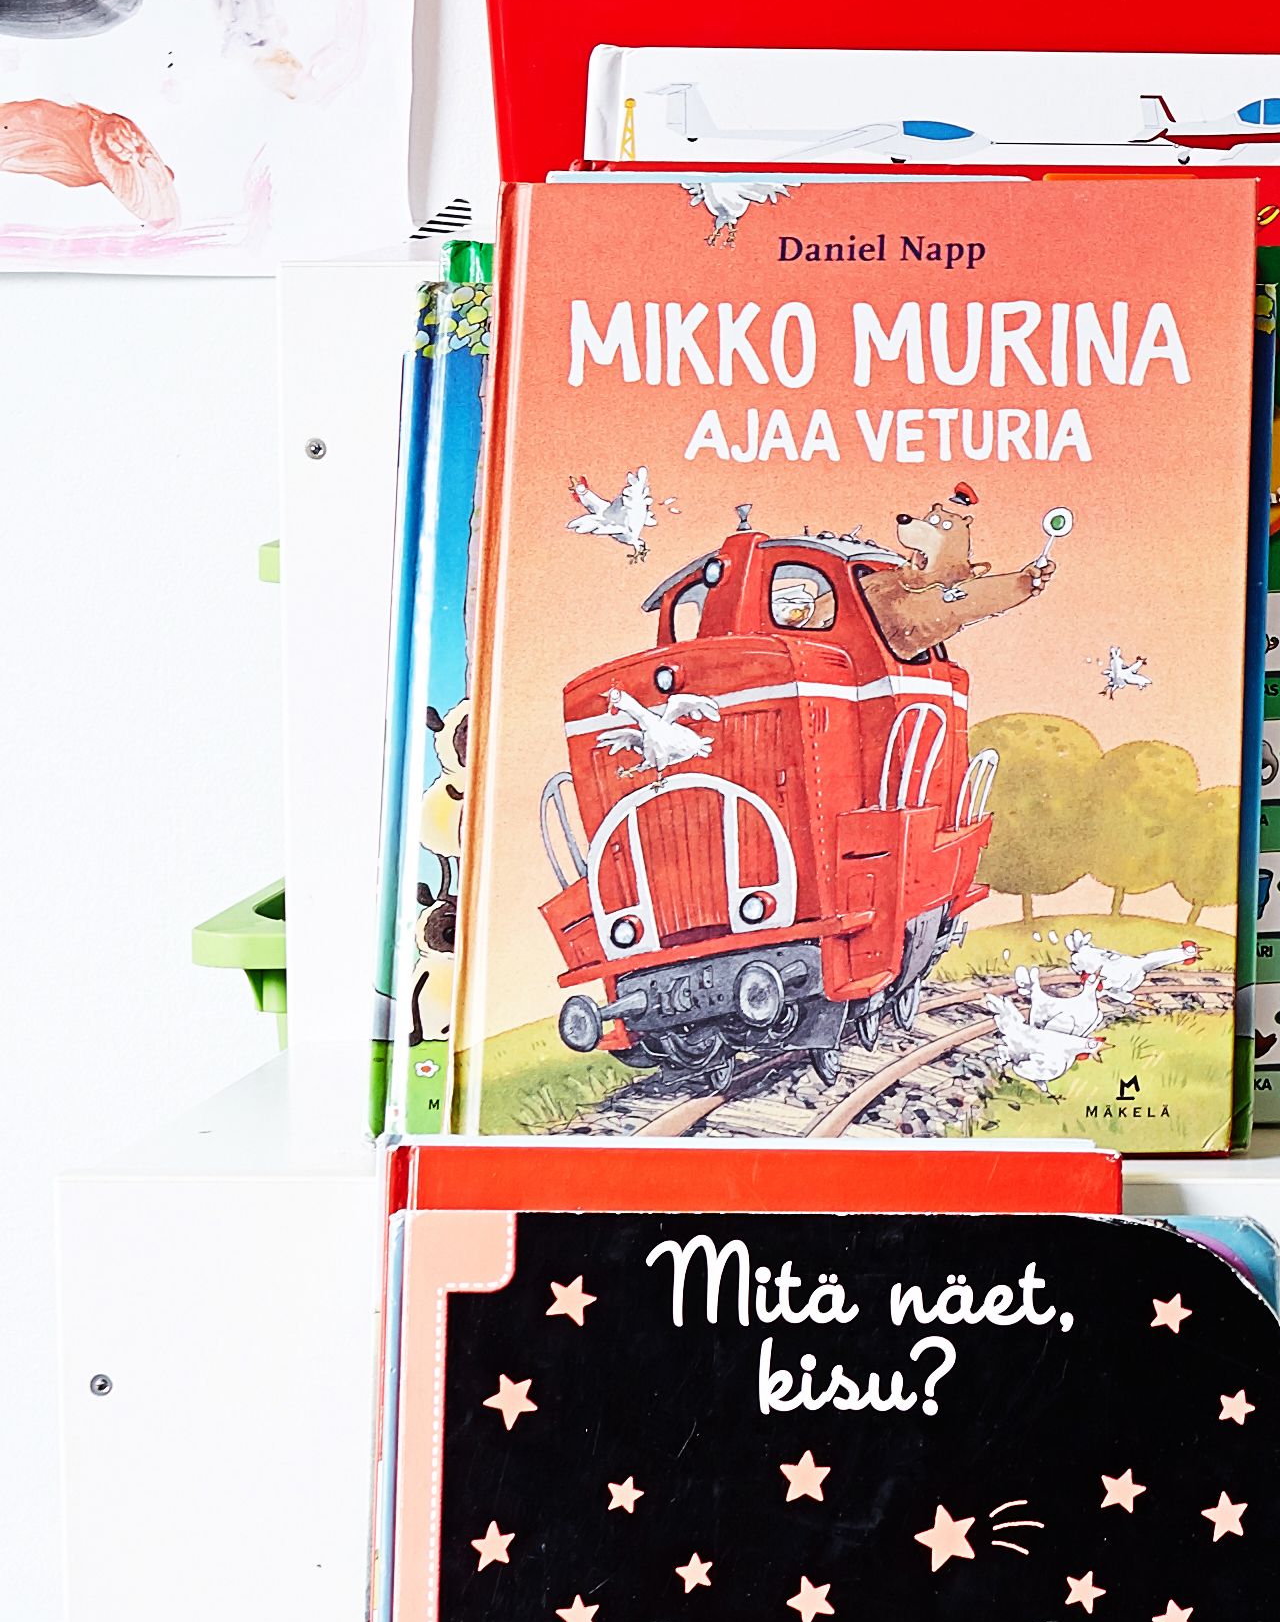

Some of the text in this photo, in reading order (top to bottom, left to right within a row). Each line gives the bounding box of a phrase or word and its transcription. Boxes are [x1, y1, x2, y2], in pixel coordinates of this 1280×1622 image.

[777, 233, 986, 270] Daniel Napp
[567, 300, 1191, 389] MIKKO MURINA
[684, 407, 1092, 463] AJAA VETURIA
[1085, 1104, 1170, 1118] MÄKELÄ
[645, 1234, 1074, 1333] Mitä näet,
[758, 1335, 957, 1416] kisu?
